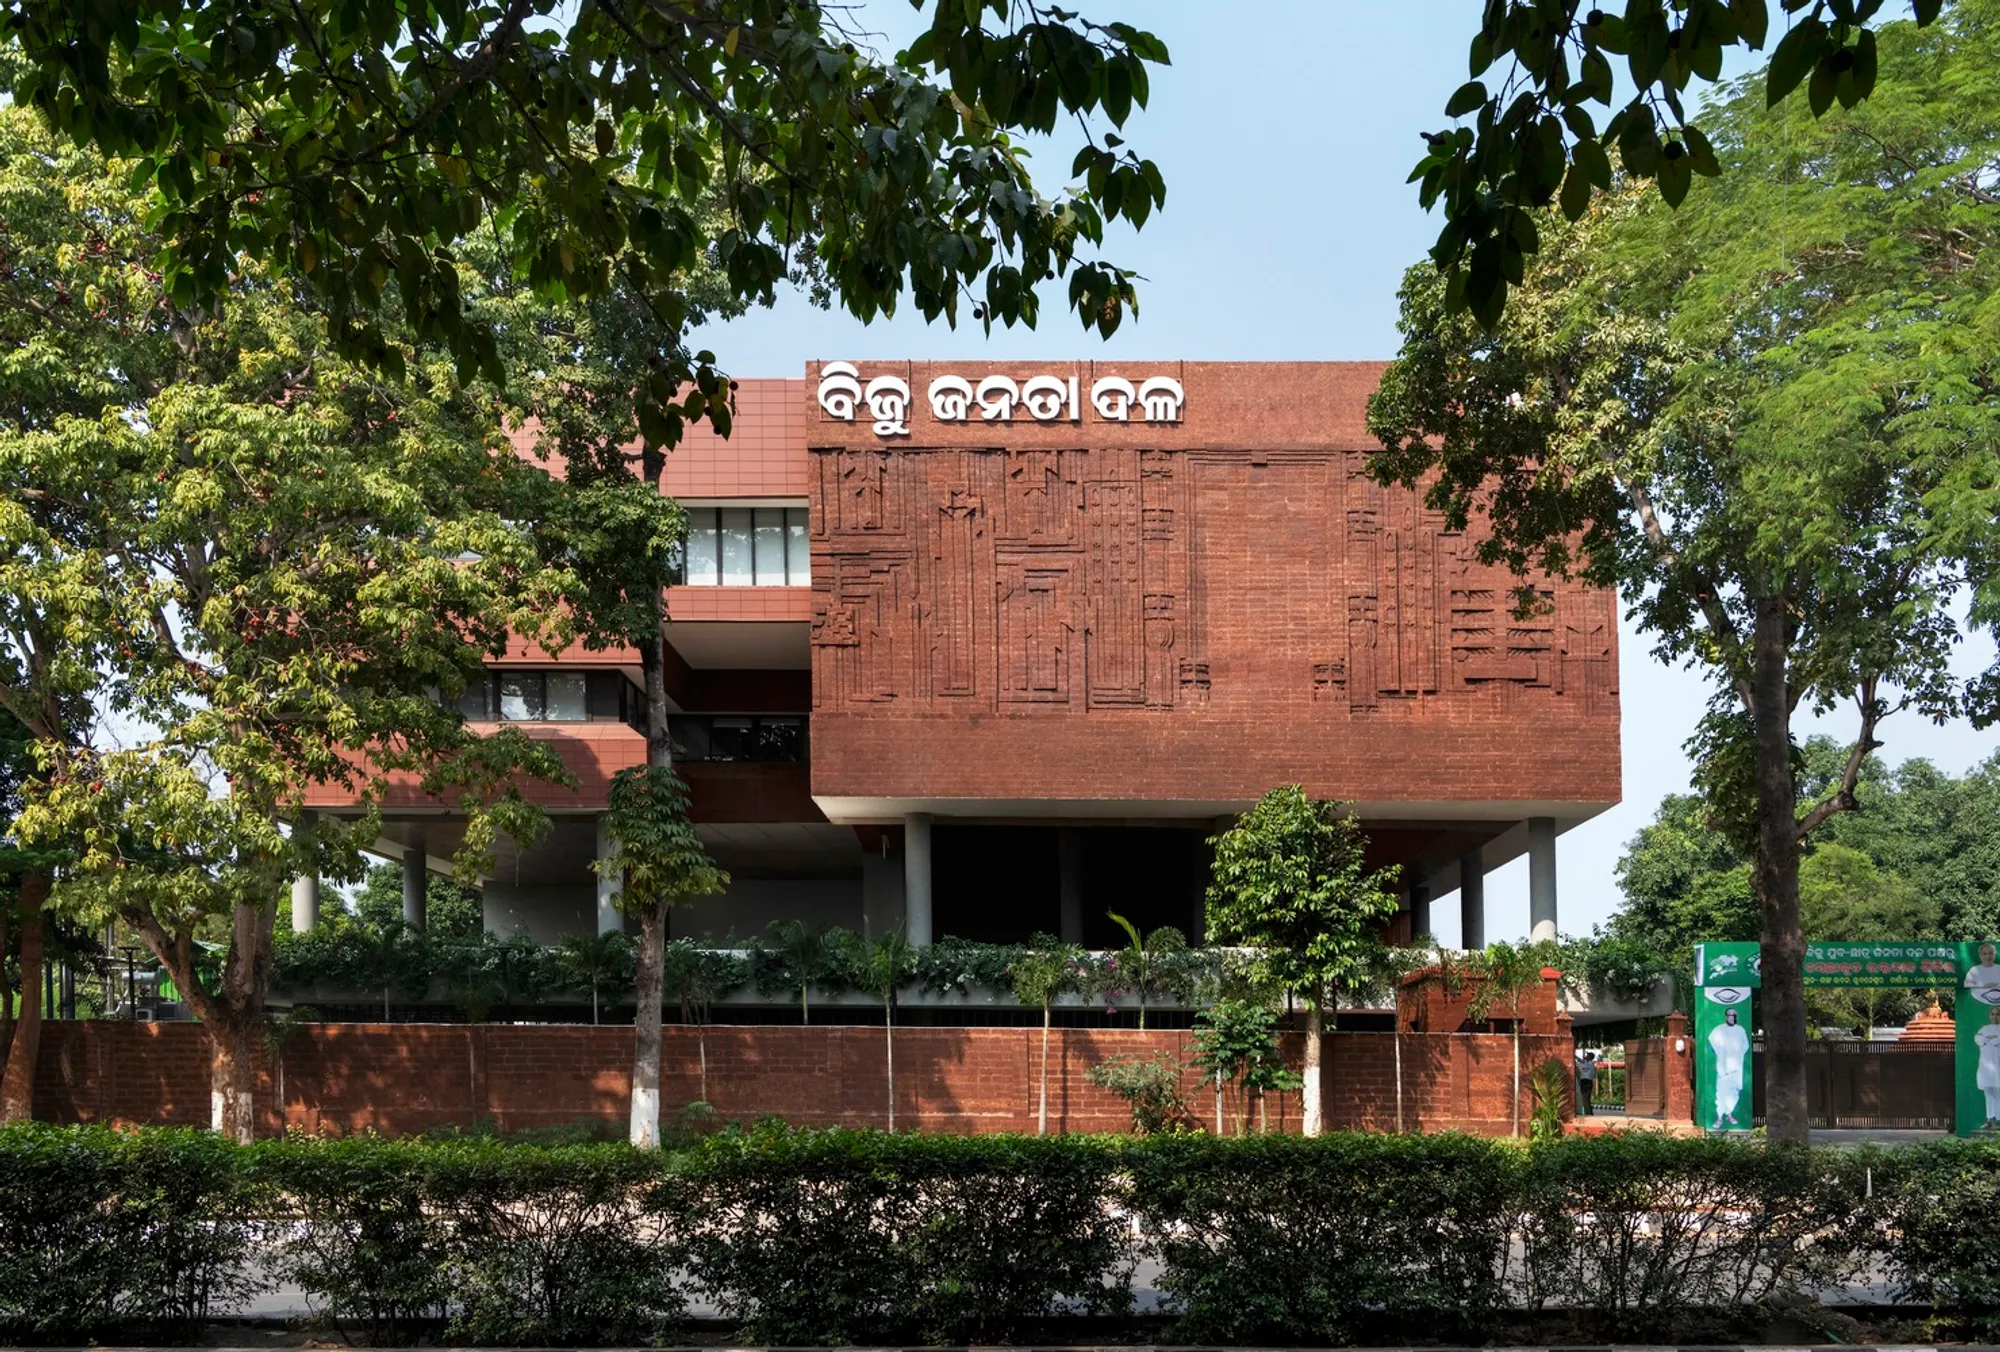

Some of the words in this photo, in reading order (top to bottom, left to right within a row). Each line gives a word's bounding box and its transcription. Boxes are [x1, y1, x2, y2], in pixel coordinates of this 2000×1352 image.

[817, 361, 911, 436] ବିଜୁ
[927, 374, 1079, 421] ଜନତା
[1090, 375, 1184, 422] ଦଳ
[1873, 947, 1903, 958] ଜନତା
